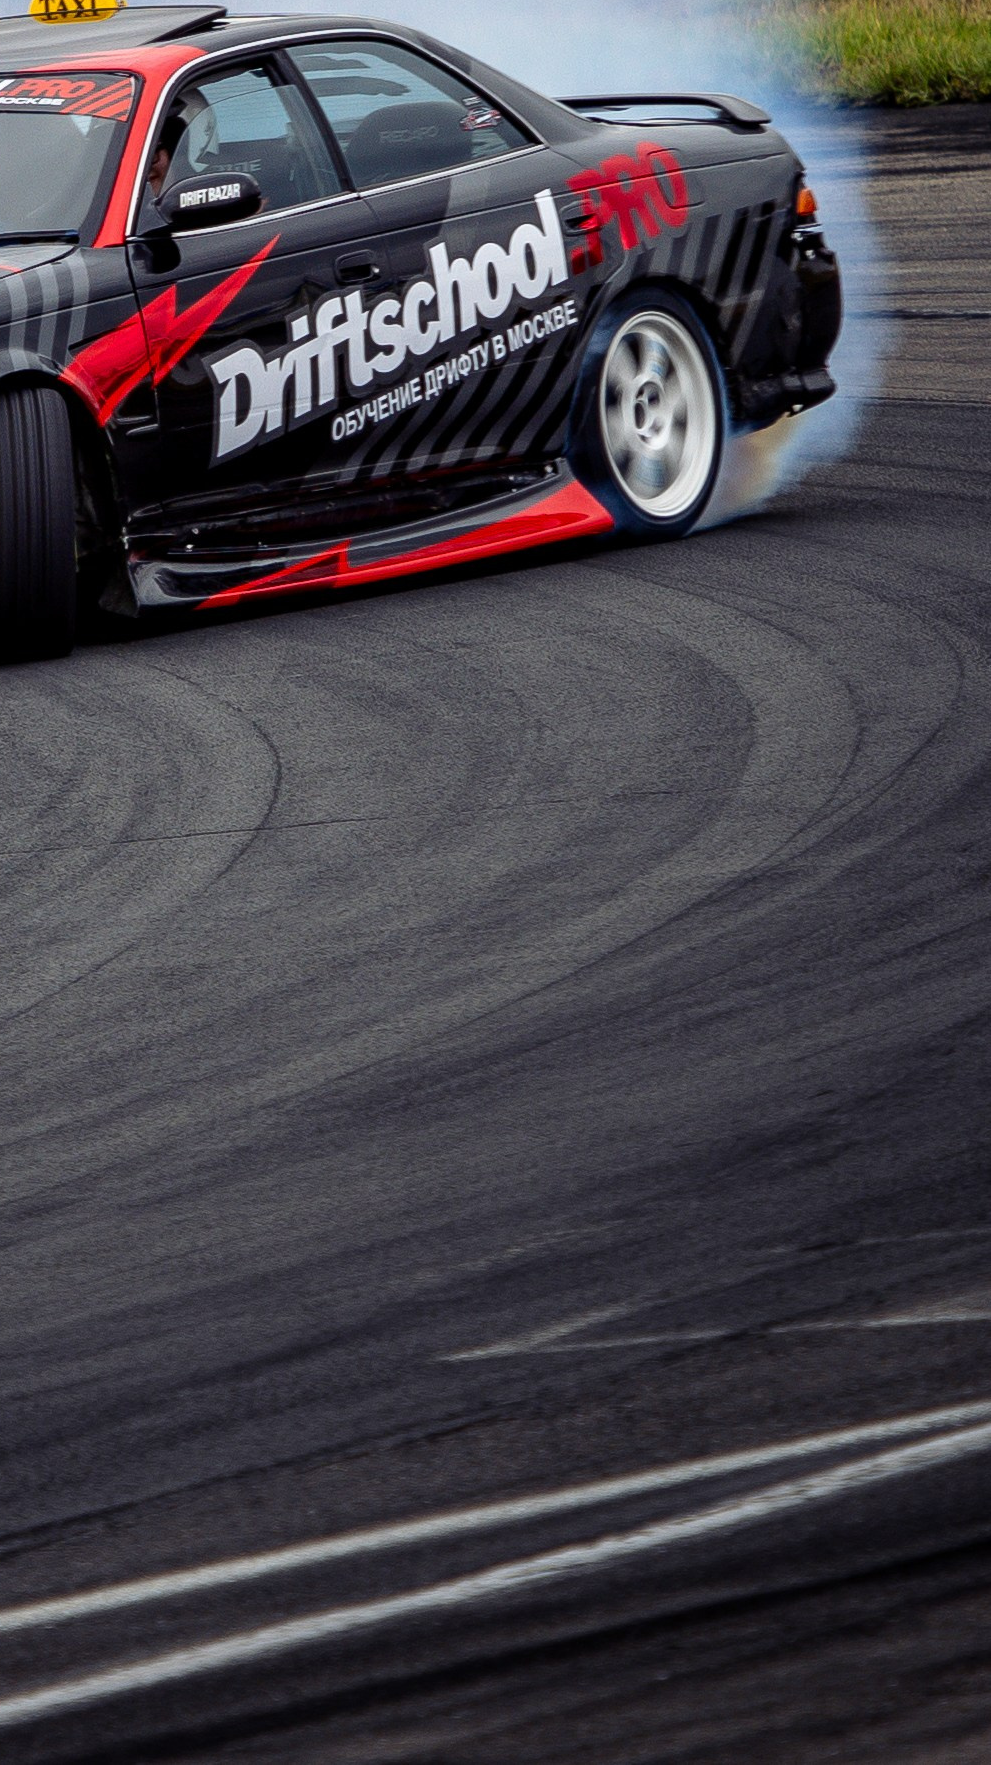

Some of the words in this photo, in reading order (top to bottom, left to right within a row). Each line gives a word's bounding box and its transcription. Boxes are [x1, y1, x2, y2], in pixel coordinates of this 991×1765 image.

[179, 188, 207, 209] DRIFT
[208, 183, 241, 203] BAZAR
[331, 376, 423, 442] ОБУЧЕНИЕ
[424, 339, 490, 401] ДРИФТУ
[490, 333, 507, 361] В
[506, 298, 579, 353] МОСКВЕ
